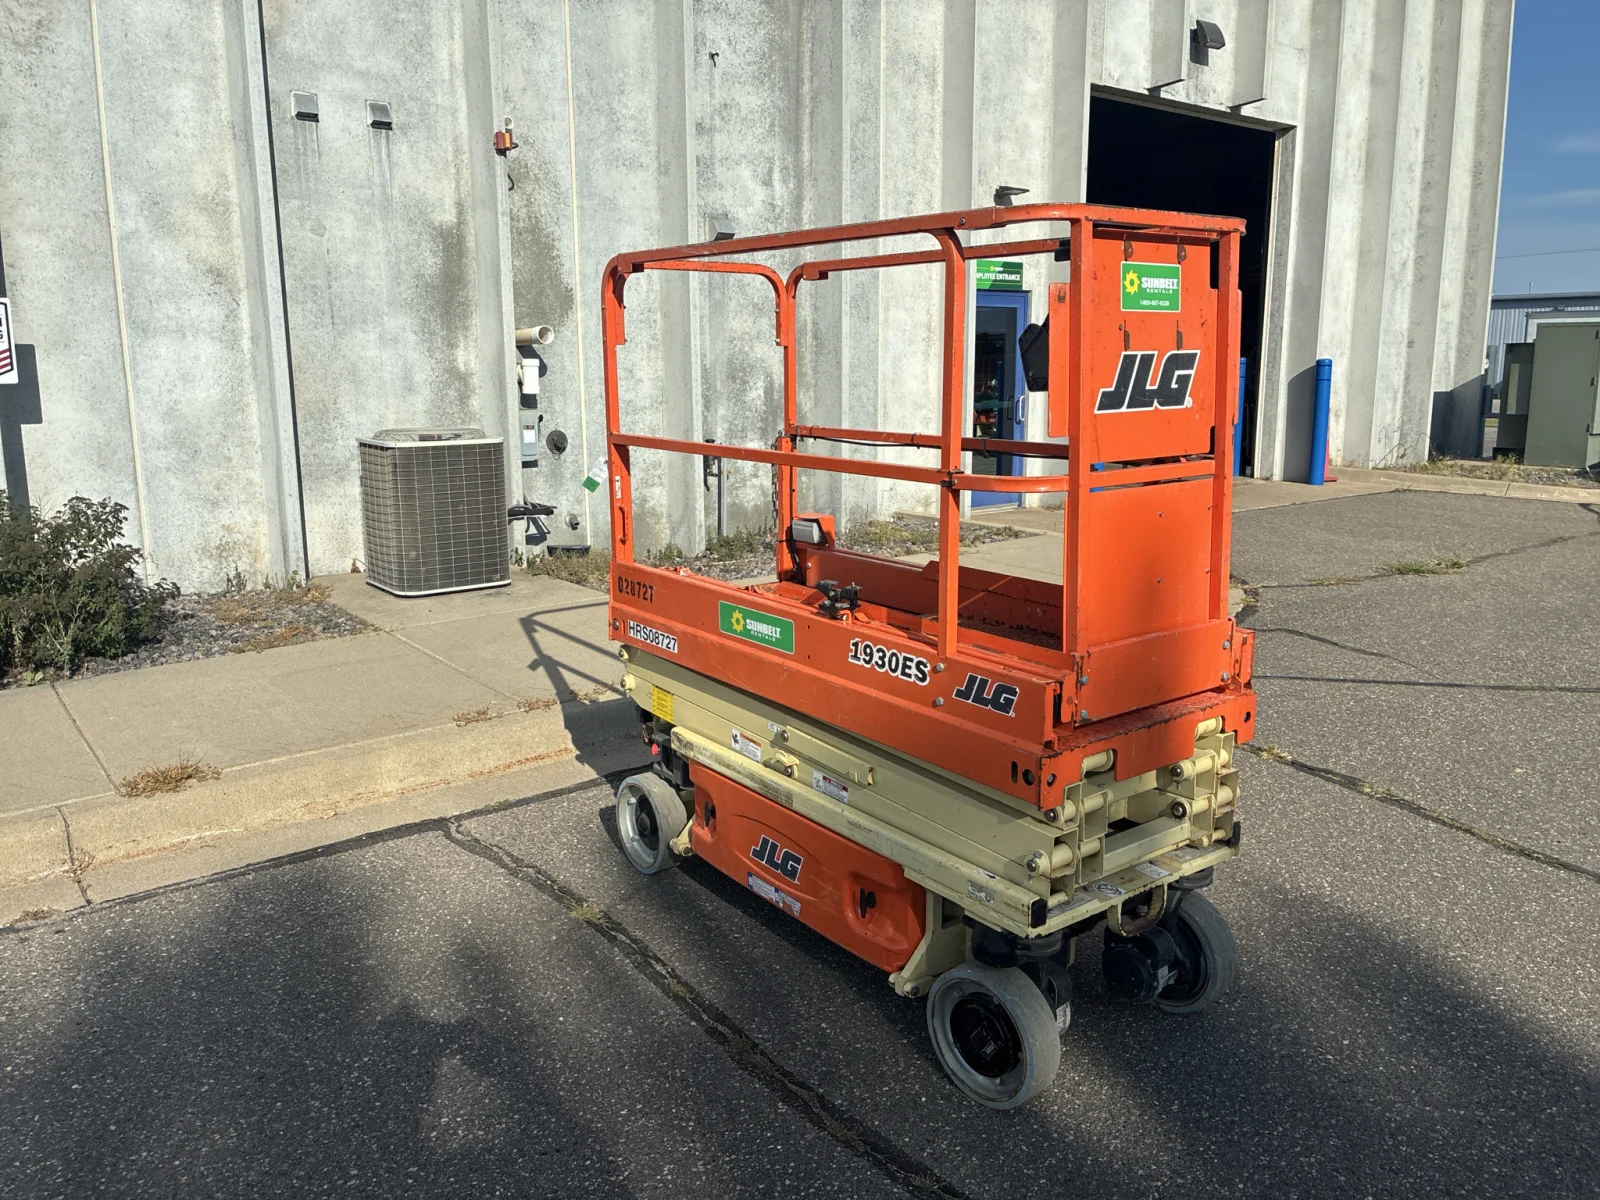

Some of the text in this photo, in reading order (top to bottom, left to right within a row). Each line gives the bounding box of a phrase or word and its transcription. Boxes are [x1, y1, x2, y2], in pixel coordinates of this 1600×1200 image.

[996, 273, 1021, 281] ENTRANCE
[1141, 277, 1178, 290] SUNBELT
[1094, 350, 1201, 414] JLG
[628, 621, 677, 651] HRS08727
[746, 618, 781, 639] SUNBELT
[750, 630, 776, 642] RENTALS
[849, 638, 930, 685] 1930ES
[952, 673, 1019, 717] JLG
[749, 834, 804, 884] JLG
